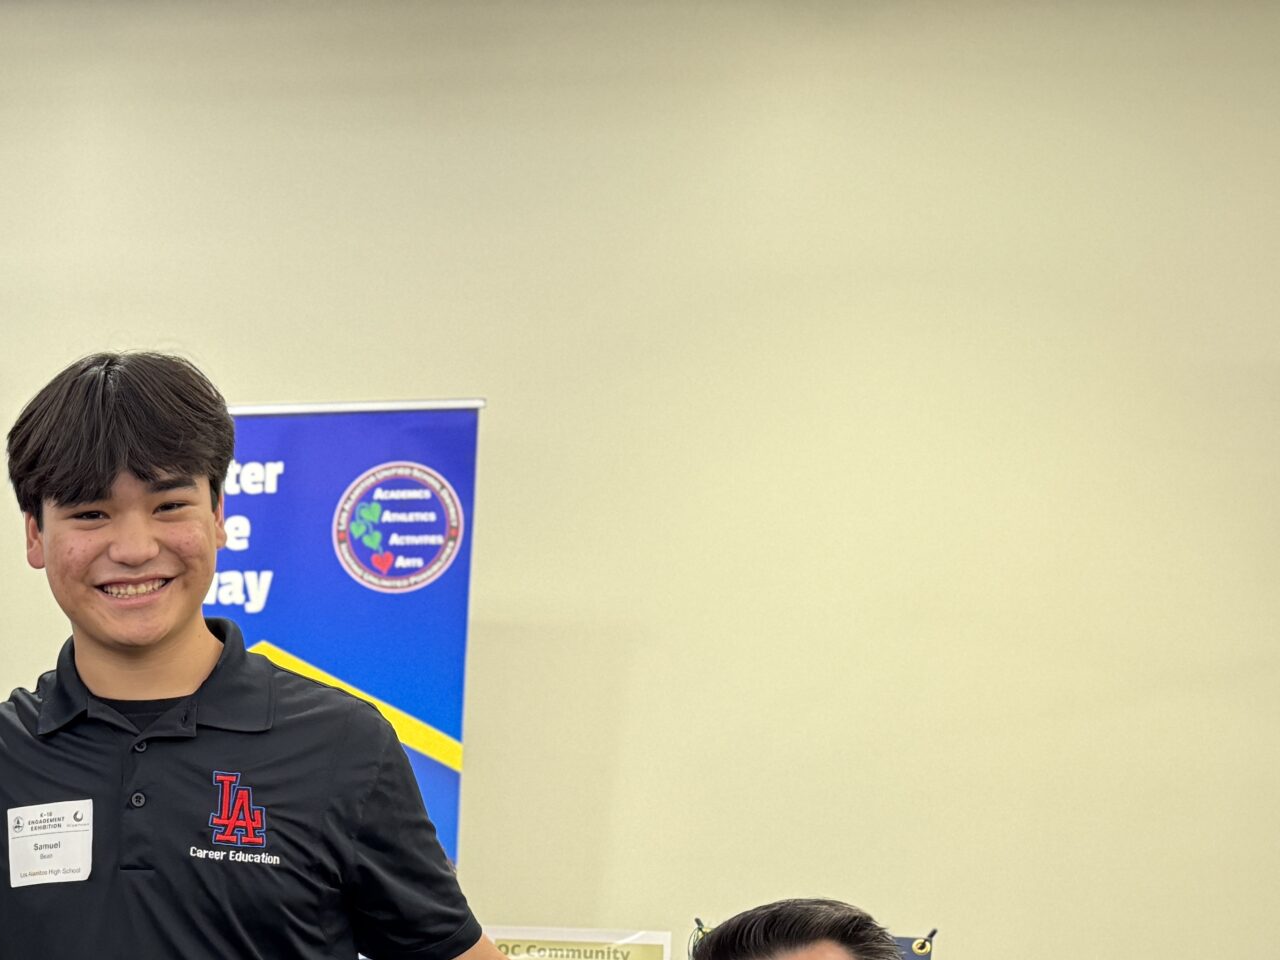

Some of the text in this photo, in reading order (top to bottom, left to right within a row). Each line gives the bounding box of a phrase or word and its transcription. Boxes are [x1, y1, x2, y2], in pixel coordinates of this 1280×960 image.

[208, 770, 267, 848] LA
[33, 841, 61, 851] Samuel
[189, 846, 280, 865] Career Education
[497, 943, 521, 956] OC
